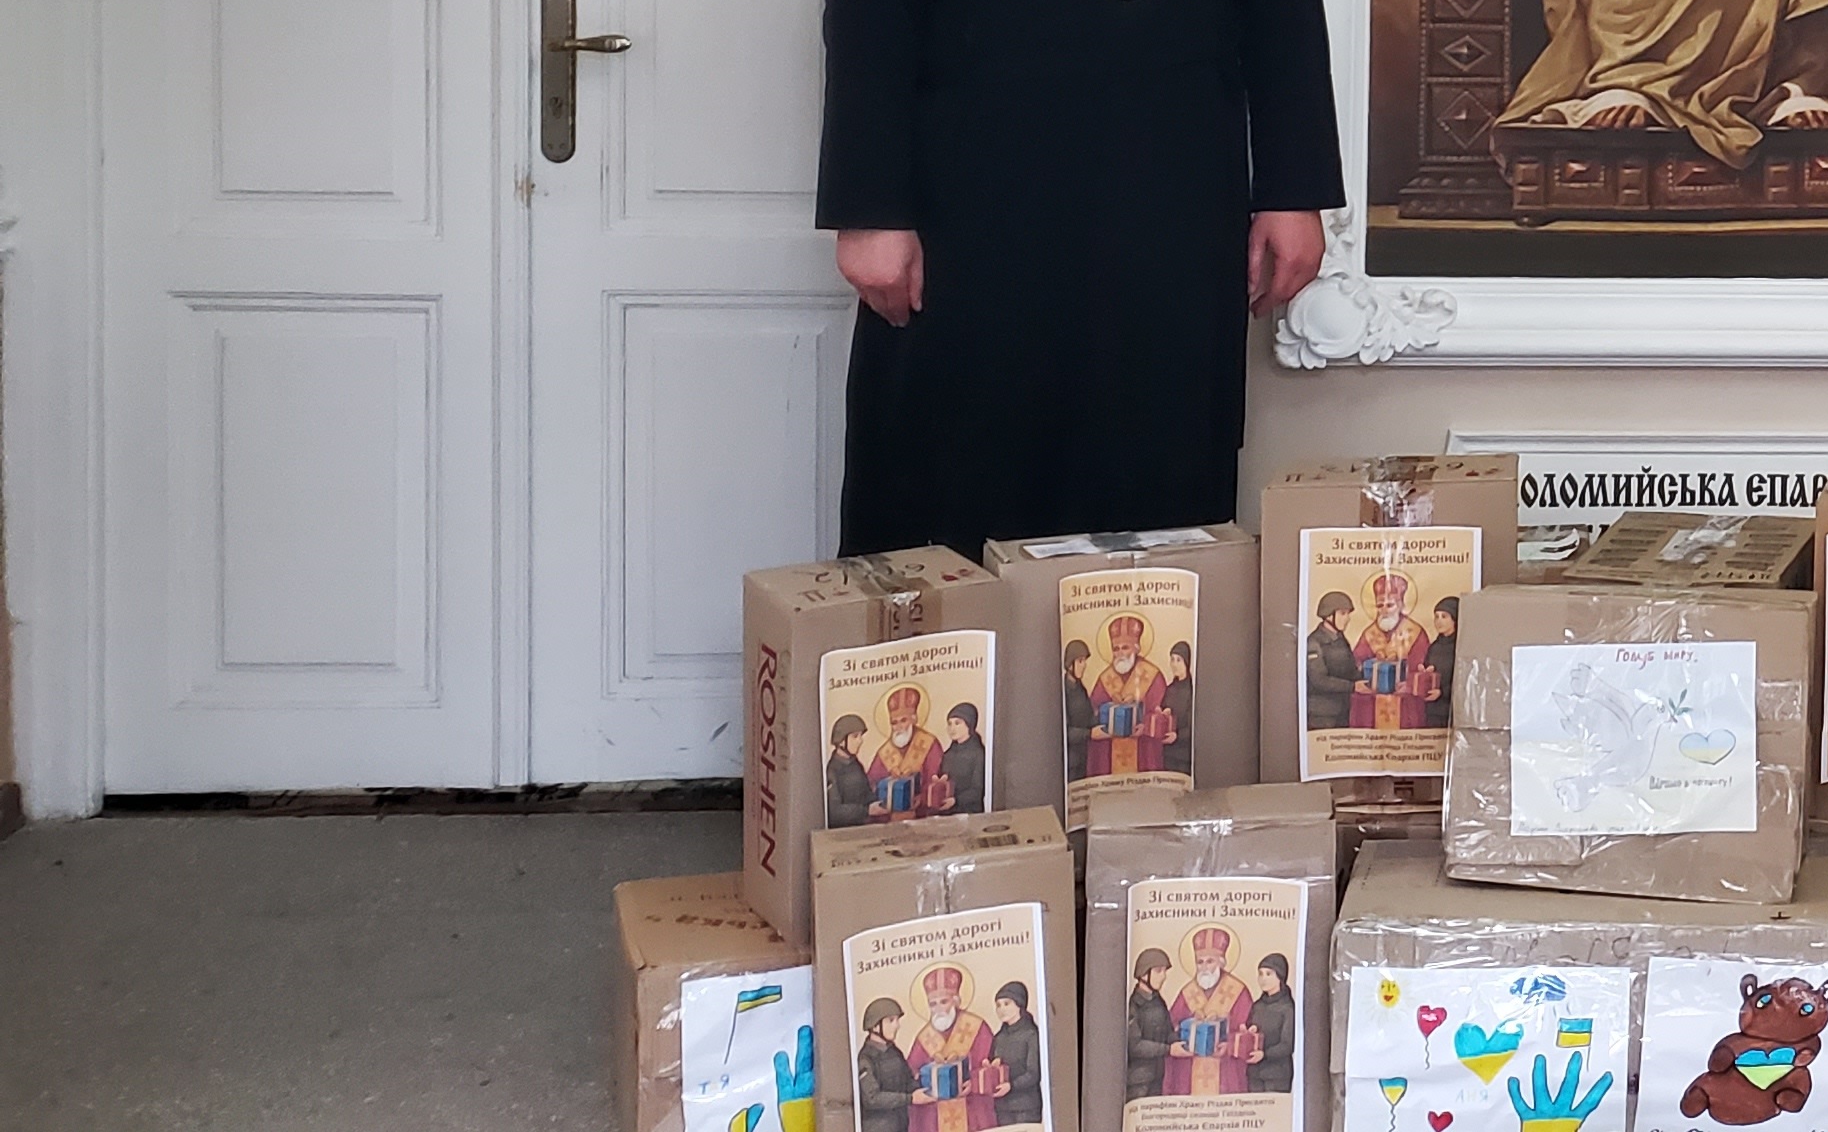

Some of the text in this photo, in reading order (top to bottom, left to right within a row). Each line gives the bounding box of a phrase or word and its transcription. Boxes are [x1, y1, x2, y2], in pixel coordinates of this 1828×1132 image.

[1517, 465, 1739, 509] ОЛОМИЙСЬКА
[1315, 553, 1385, 565] Захисники
[1398, 552, 1469, 565] Захисниці!
[1331, 537, 1344, 550] Зі
[1401, 537, 1446, 552] дорогі
[1071, 580, 1180, 597] Зі святом дорогі
[842, 643, 959, 672] Зі святом дорогі
[828, 671, 899, 691] Захисники
[910, 657, 984, 676] Захисниці!
[757, 643, 777, 878] ROSHEN
[1148, 890, 1272, 905] Зі святом дорогі
[1134, 908, 1207, 923] Захисники
[1220, 905, 1296, 920] Захисниці!
[872, 920, 1002, 954] Зі святом дорогі
[856, 950, 935, 975] Захисники
[949, 931, 1030, 956] Захисниці!
